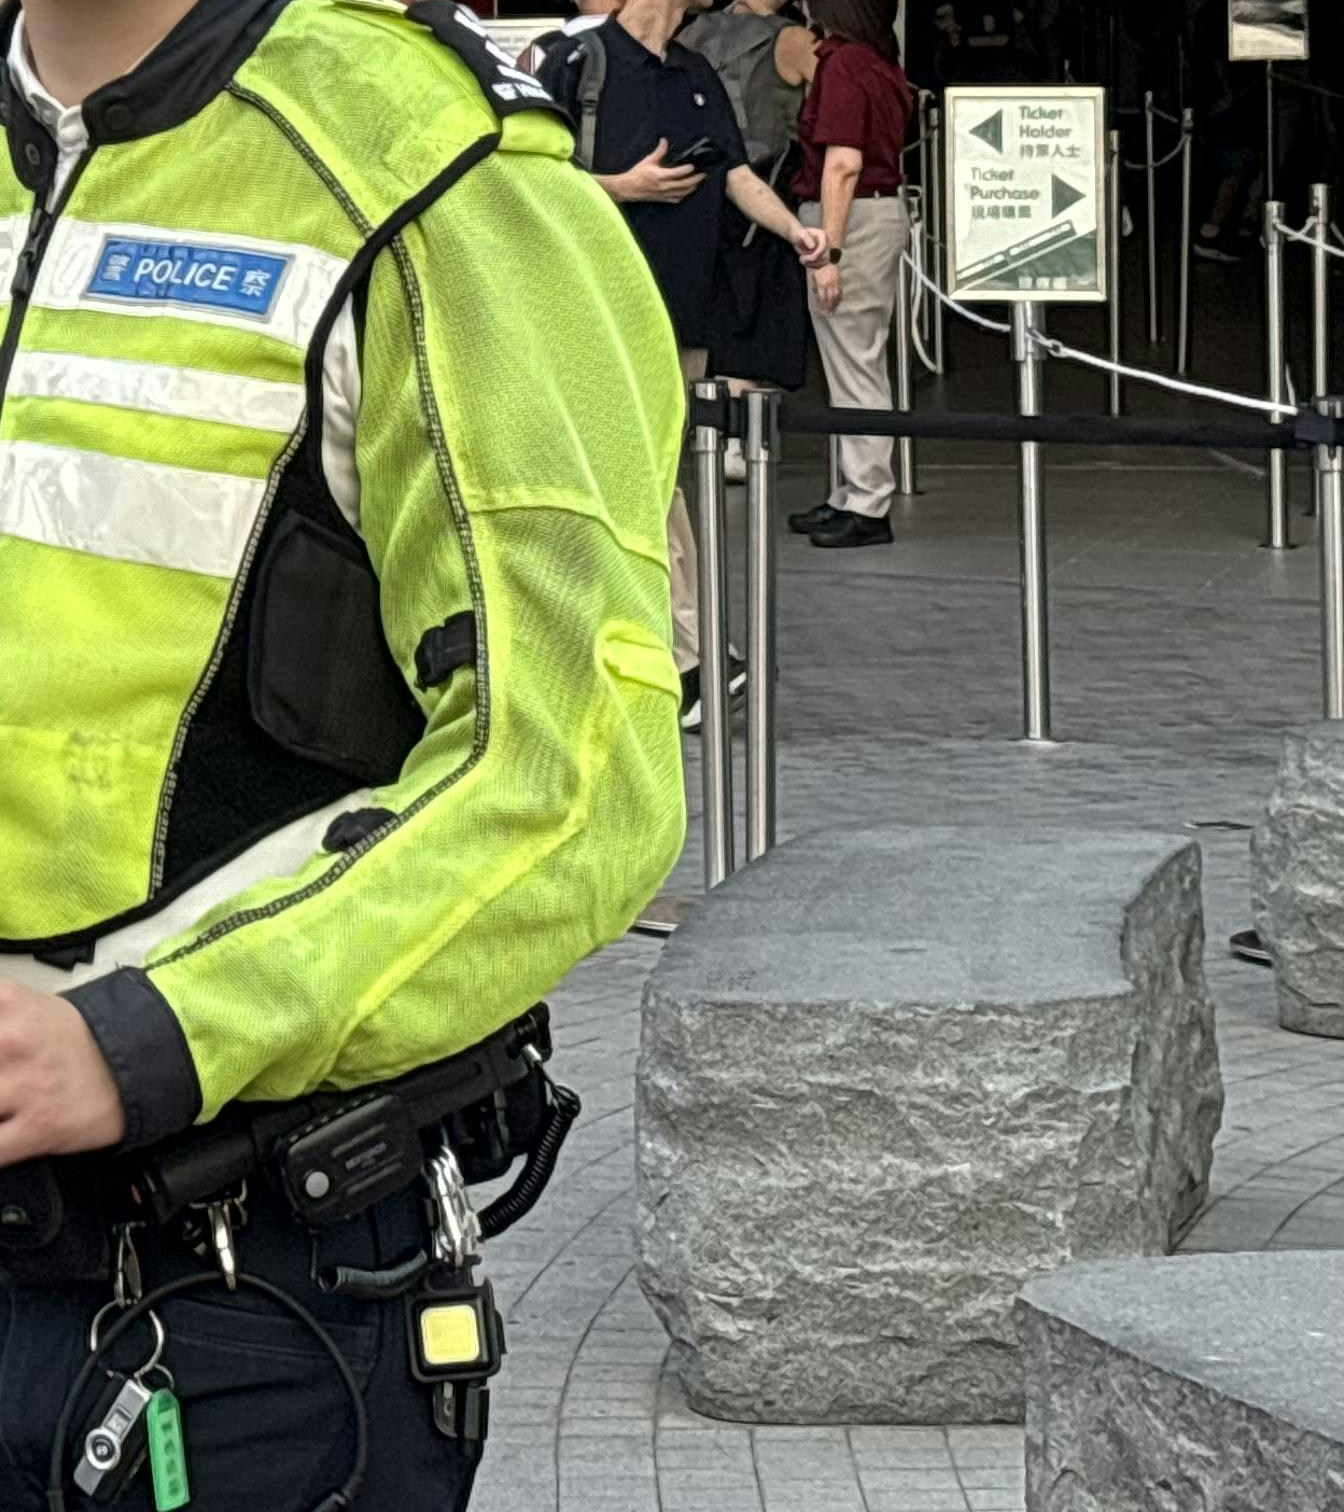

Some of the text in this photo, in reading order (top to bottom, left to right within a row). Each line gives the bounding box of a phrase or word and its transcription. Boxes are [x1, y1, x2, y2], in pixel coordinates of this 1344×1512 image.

[1019, 104, 1064, 120] Ticket
[1019, 124, 1072, 139] Holder
[971, 166, 1015, 182] Ticket
[970, 185, 1041, 201] Purchase
[133, 257, 237, 292] POLICE
[238, 269, 272, 297] 察
